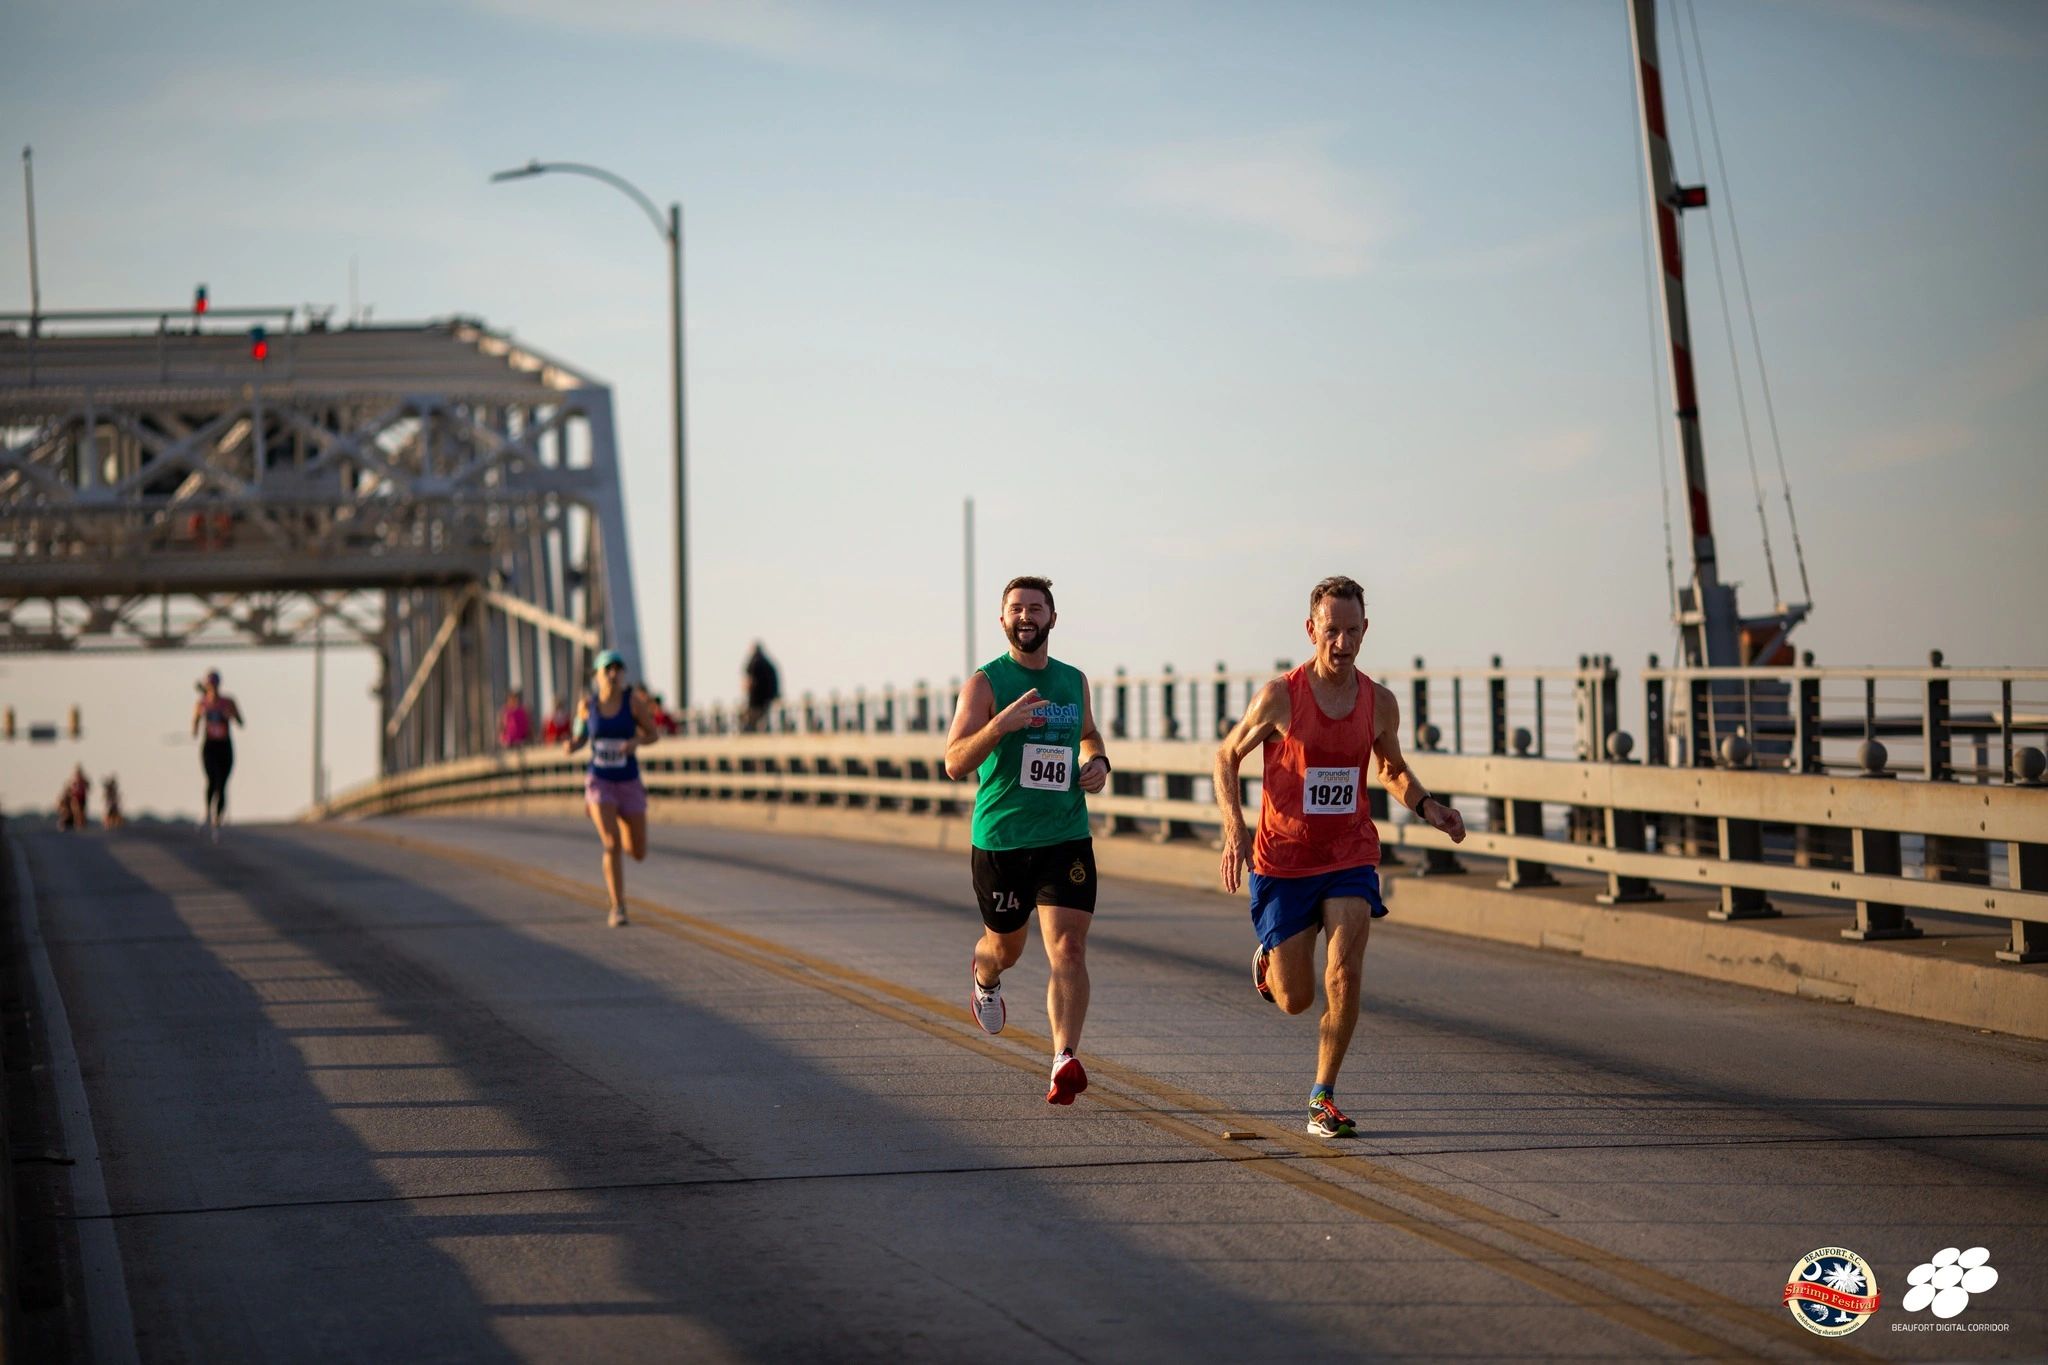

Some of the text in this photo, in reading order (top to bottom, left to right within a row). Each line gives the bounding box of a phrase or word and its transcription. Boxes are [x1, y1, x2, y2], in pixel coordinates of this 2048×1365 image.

[1036, 747, 1064, 755] grounded
[1030, 760, 1066, 783] 948
[1309, 785, 1353, 805] 1928
[992, 891, 1020, 913] 24
